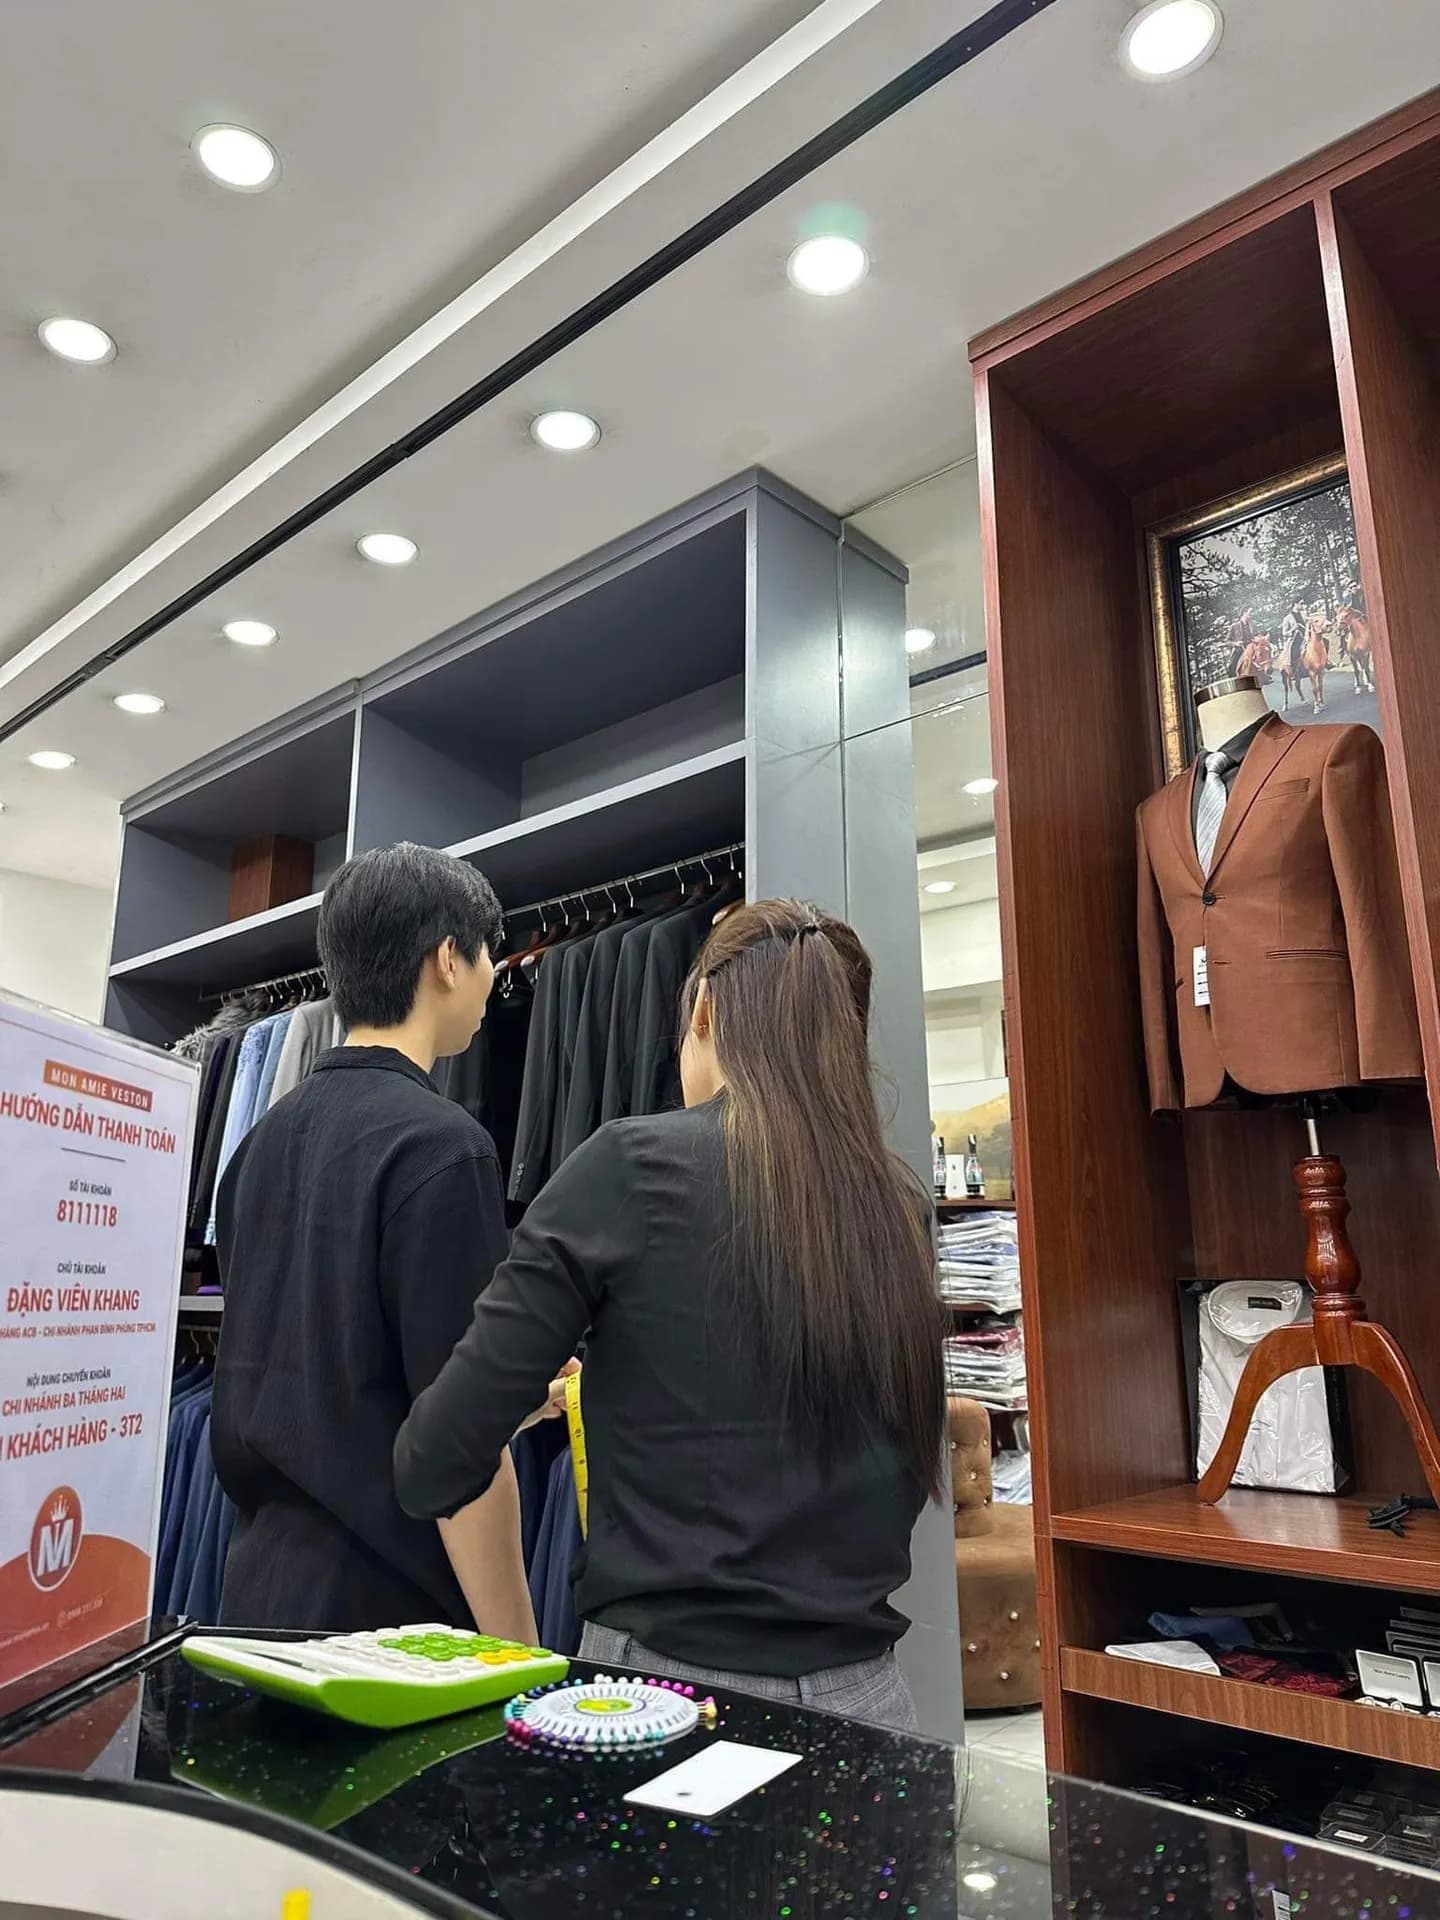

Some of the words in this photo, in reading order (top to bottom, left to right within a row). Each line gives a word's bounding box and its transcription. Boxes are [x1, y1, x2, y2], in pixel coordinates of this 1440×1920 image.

[51, 1068, 77, 1088] MON
[81, 1077, 108, 1097] AMIE
[111, 1086, 149, 1109] VESTON
[0, 1091, 60, 1127] HƯỚNG
[63, 1102, 94, 1136] DẪN
[97, 1115, 142, 1147] THANH
[145, 1127, 176, 1154] TOÁN
[57, 1199, 118, 1227] 8111118
[7, 1281, 53, 1318] ĐẶNG
[57, 1282, 90, 1311] VIÊN
[93, 1289, 140, 1311] KHANG
[2, 1399, 22, 1416] CHI
[24, 1390, 61, 1416] NHÁNH
[63, 1394, 77, 1408] BA
[79, 1386, 109, 1406] THÁNG
[110, 1385, 126, 1401] HAI
[7, 1423, 65, 1461] KHÁCH
[67, 1415, 109, 1448] HÀNG
[119, 1412, 144, 1438] 3T2
